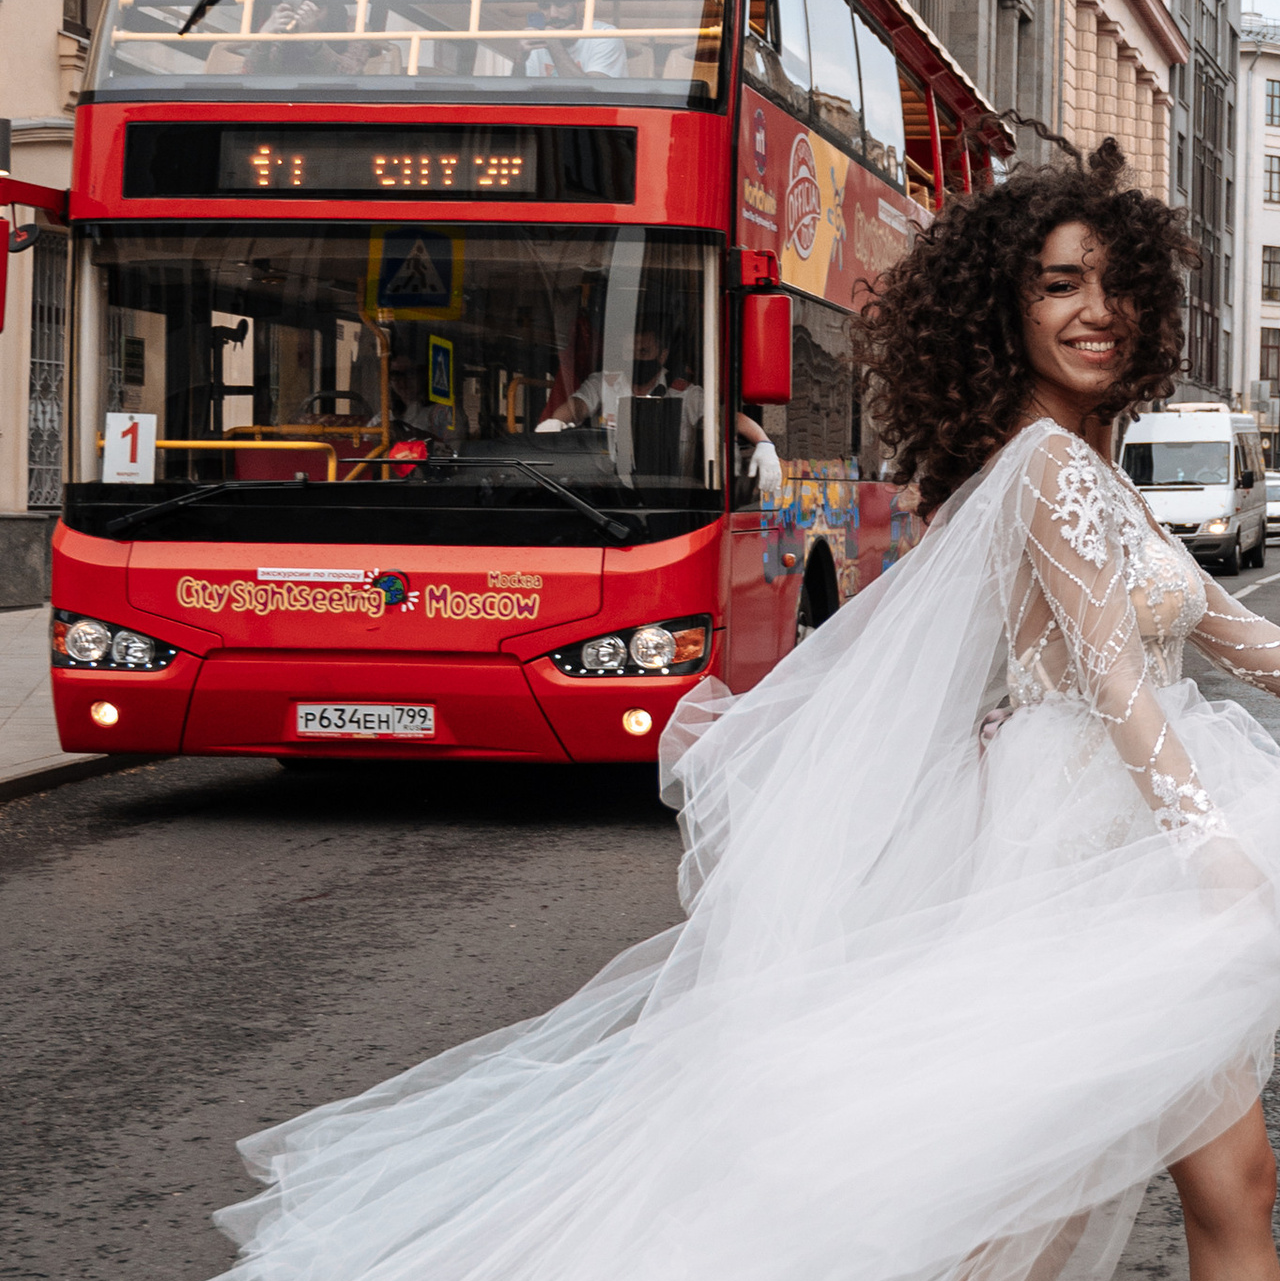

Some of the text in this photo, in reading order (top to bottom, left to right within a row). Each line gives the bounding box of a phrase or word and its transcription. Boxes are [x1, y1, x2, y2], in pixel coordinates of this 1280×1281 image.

[788, 181, 821, 232] OFFICIAL
[121, 422, 139, 464] 1
[177, 576, 540, 620] City Sightseeing Moscow
[487, 571, 543, 589] Москва
[395, 707, 428, 724] 799
